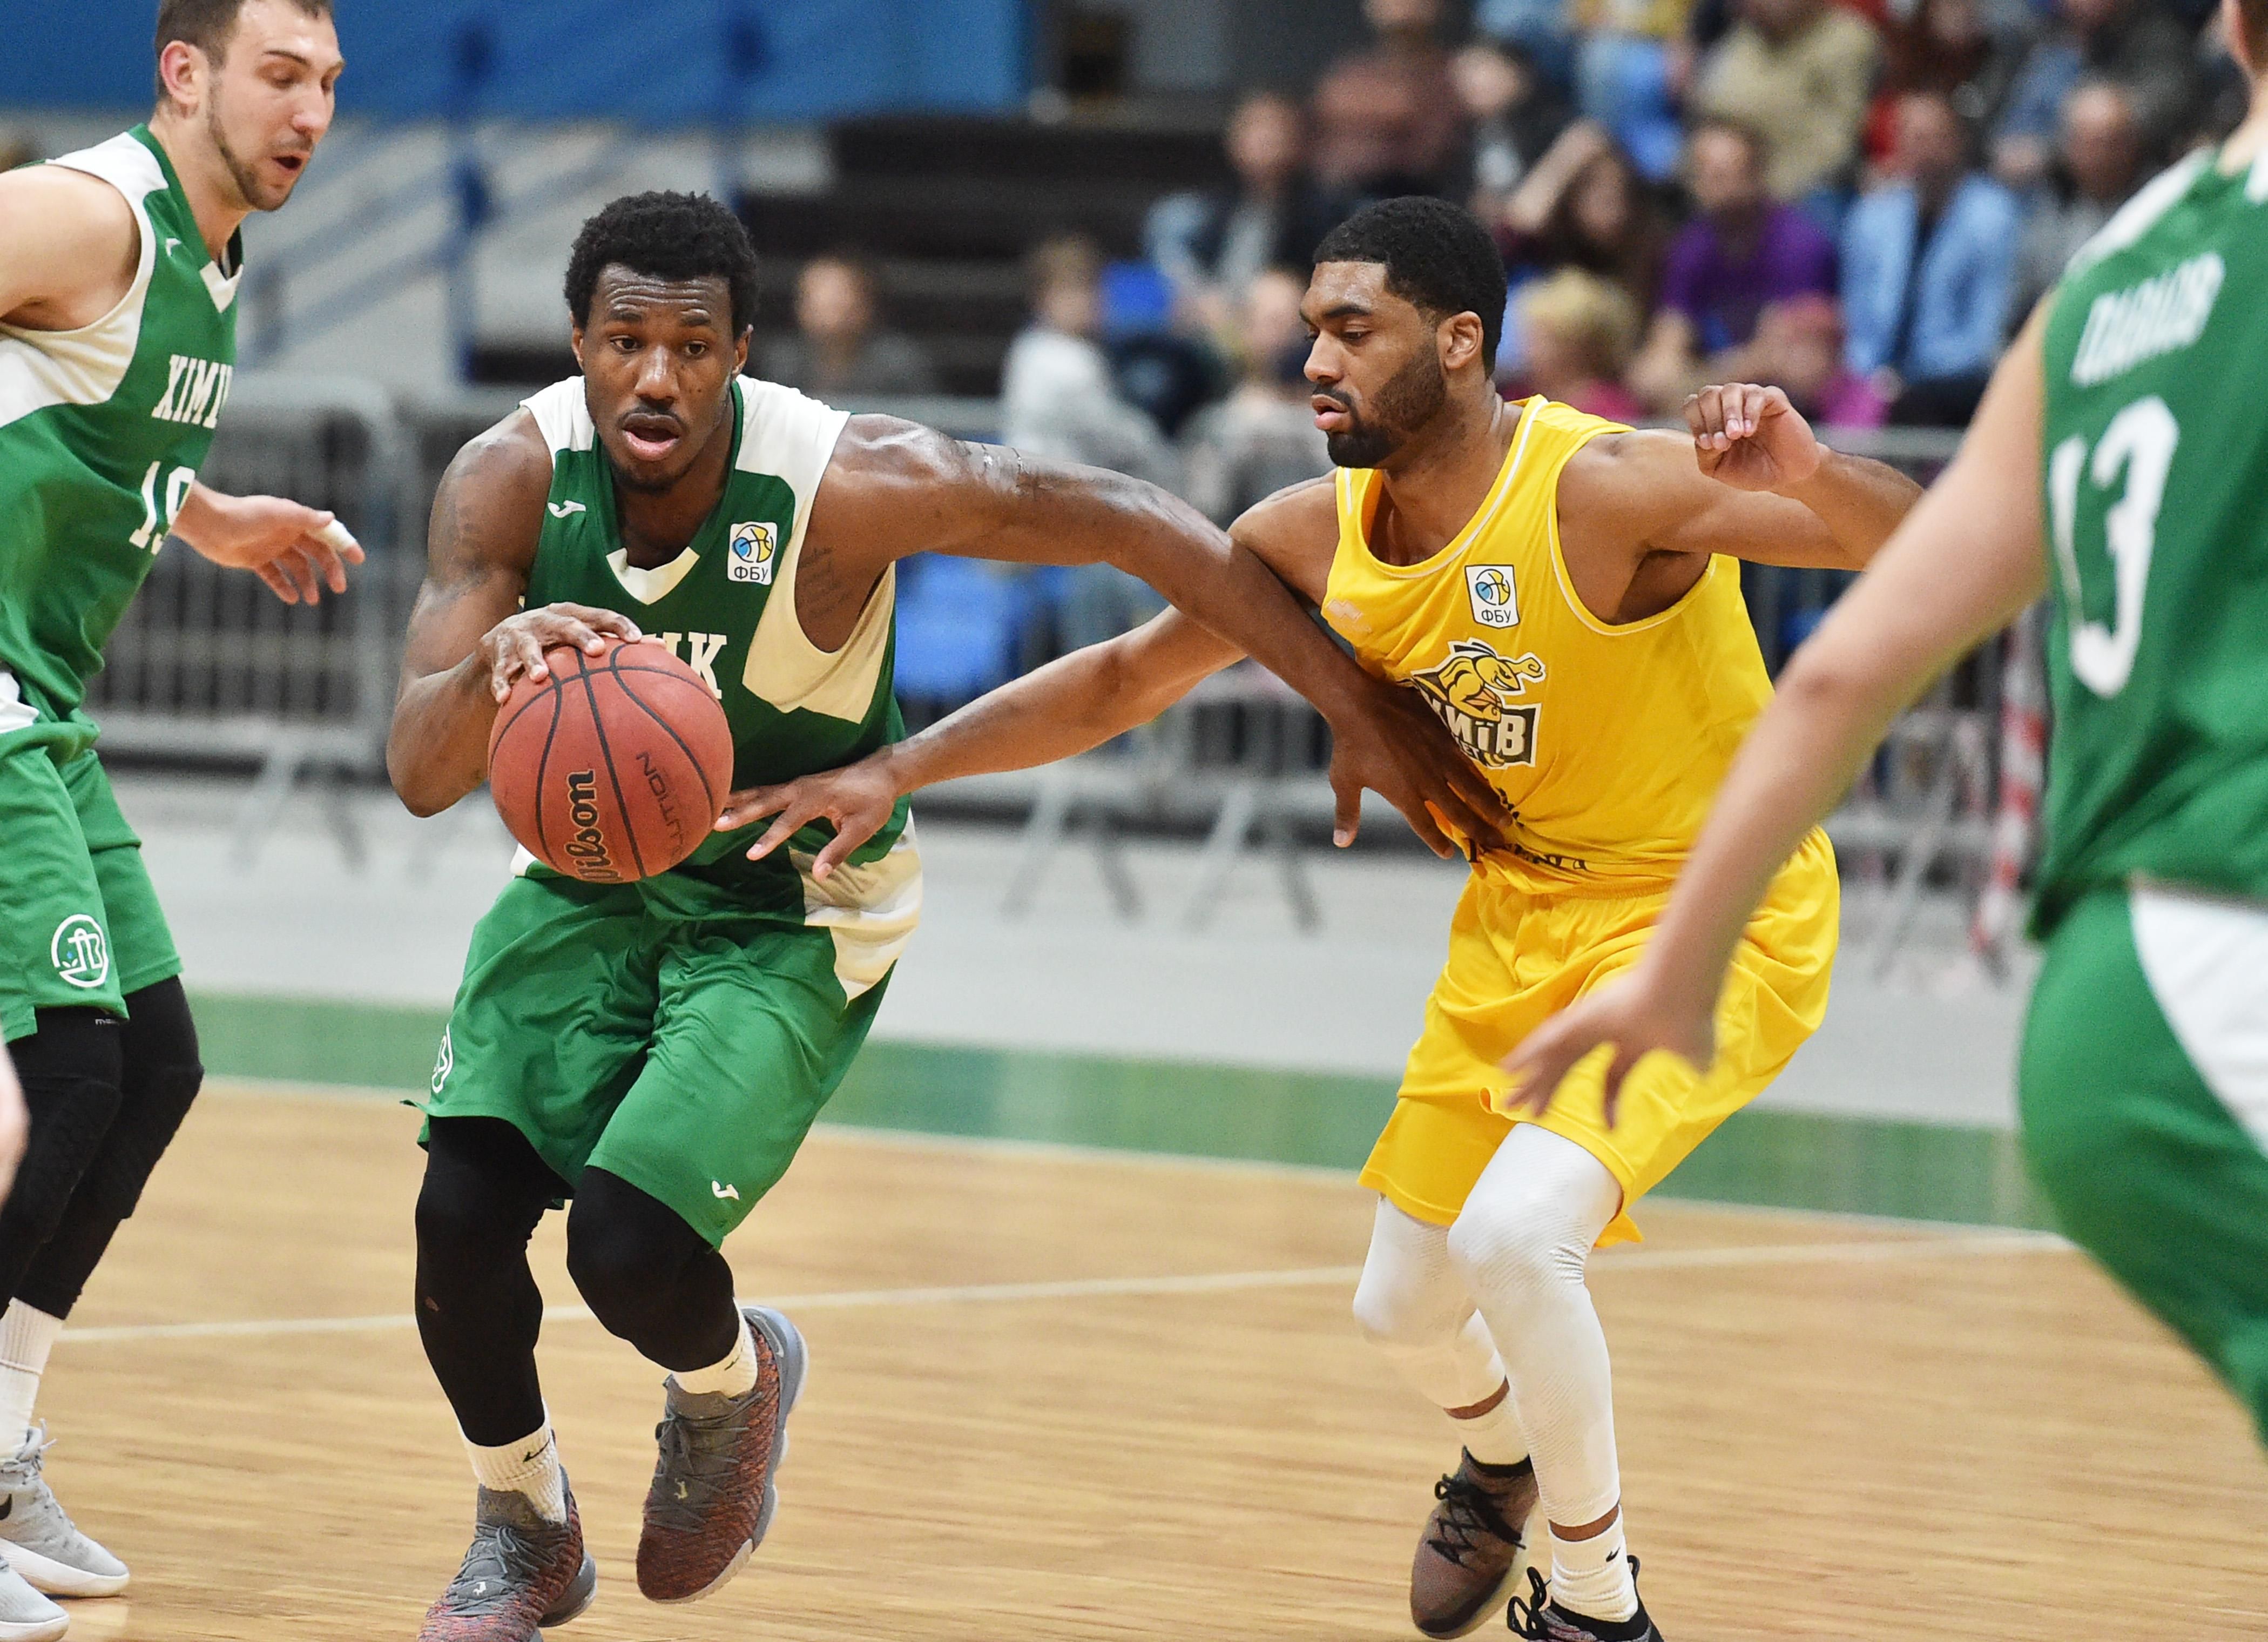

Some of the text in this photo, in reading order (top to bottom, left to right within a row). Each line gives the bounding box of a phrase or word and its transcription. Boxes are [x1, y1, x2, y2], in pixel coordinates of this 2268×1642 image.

[2049, 395, 2179, 698] 13
[734, 566, 768, 582] ФБУ
[1481, 609, 1511, 623] ФБУ
